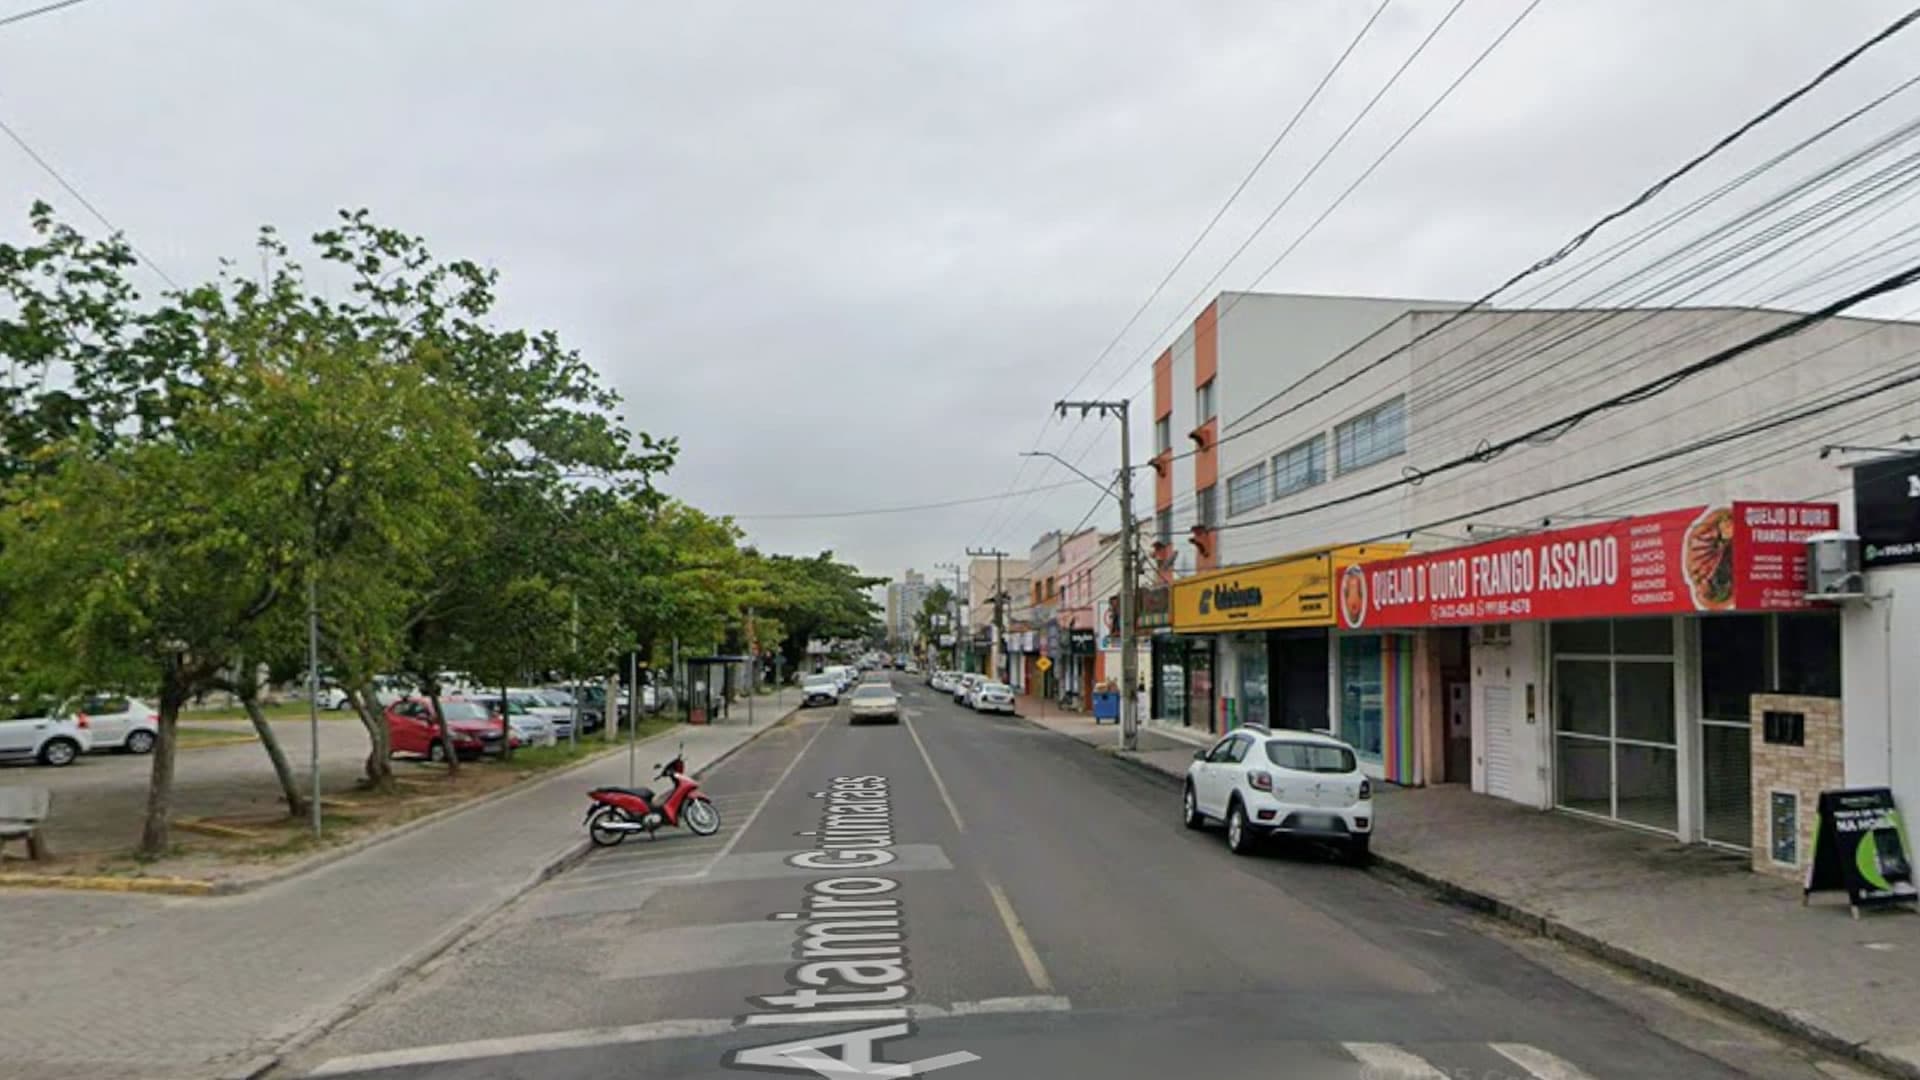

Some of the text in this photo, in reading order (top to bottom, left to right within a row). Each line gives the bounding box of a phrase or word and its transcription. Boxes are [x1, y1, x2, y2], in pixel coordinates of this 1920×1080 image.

[1744, 506, 1787, 528] QUEIJO
[1751, 529, 1787, 543] FRANGO
[1372, 565, 1415, 611] QUEIJO
[1471, 547, 1535, 598] FRANGO
[1538, 535, 1618, 592] ASSADO
[1836, 818, 1857, 832] NA
